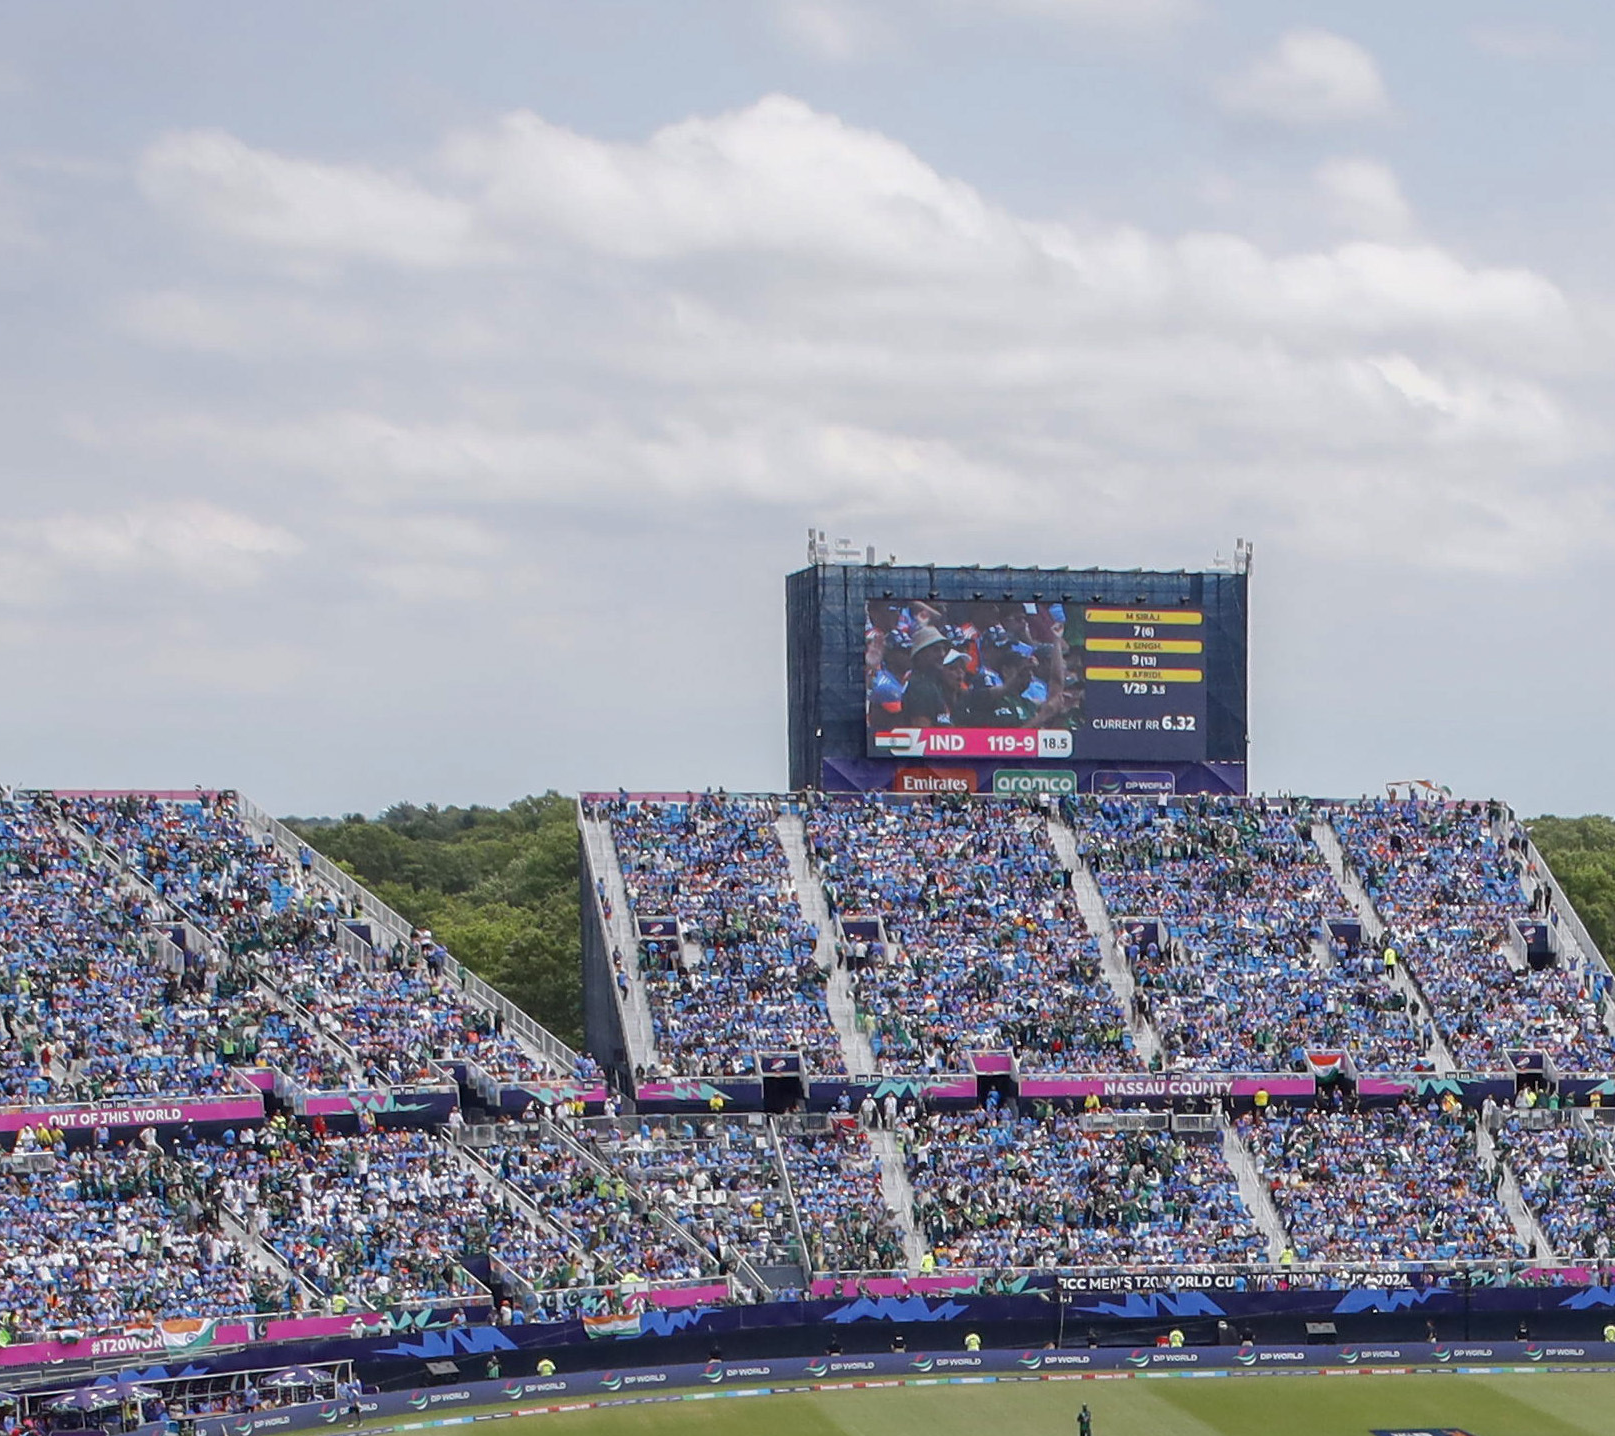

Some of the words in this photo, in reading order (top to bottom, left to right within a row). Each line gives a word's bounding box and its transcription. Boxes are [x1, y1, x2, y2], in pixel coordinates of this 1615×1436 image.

[1133, 625, 1141, 636] 7
[1141, 626, 1154, 638] (6)
[1131, 654, 1139, 665] 9
[1140, 656, 1157, 667] (13)
[1122, 683, 1147, 694] 1/29
[1092, 718, 1143, 730] CURRENT
[1145, 720, 1160, 730] RR
[1161, 716, 1196, 730] 6.32
[929, 736, 965, 751] IND
[987, 736, 1035, 751] 119-9
[1042, 738, 1068, 750] 18.5
[903, 775, 968, 792] Emirates
[997, 776, 1072, 792] aramco
[1104, 1082, 1165, 1096] NASSAU
[1168, 1081, 1233, 1095] COUNTY
[48, 1114, 79, 1126] OUT
[79, 1112, 98, 1125] OF
[100, 1110, 130, 1124] THIS
[132, 1108, 181, 1122] WORLD
[1089, 1276, 1132, 1290] MEN'S
